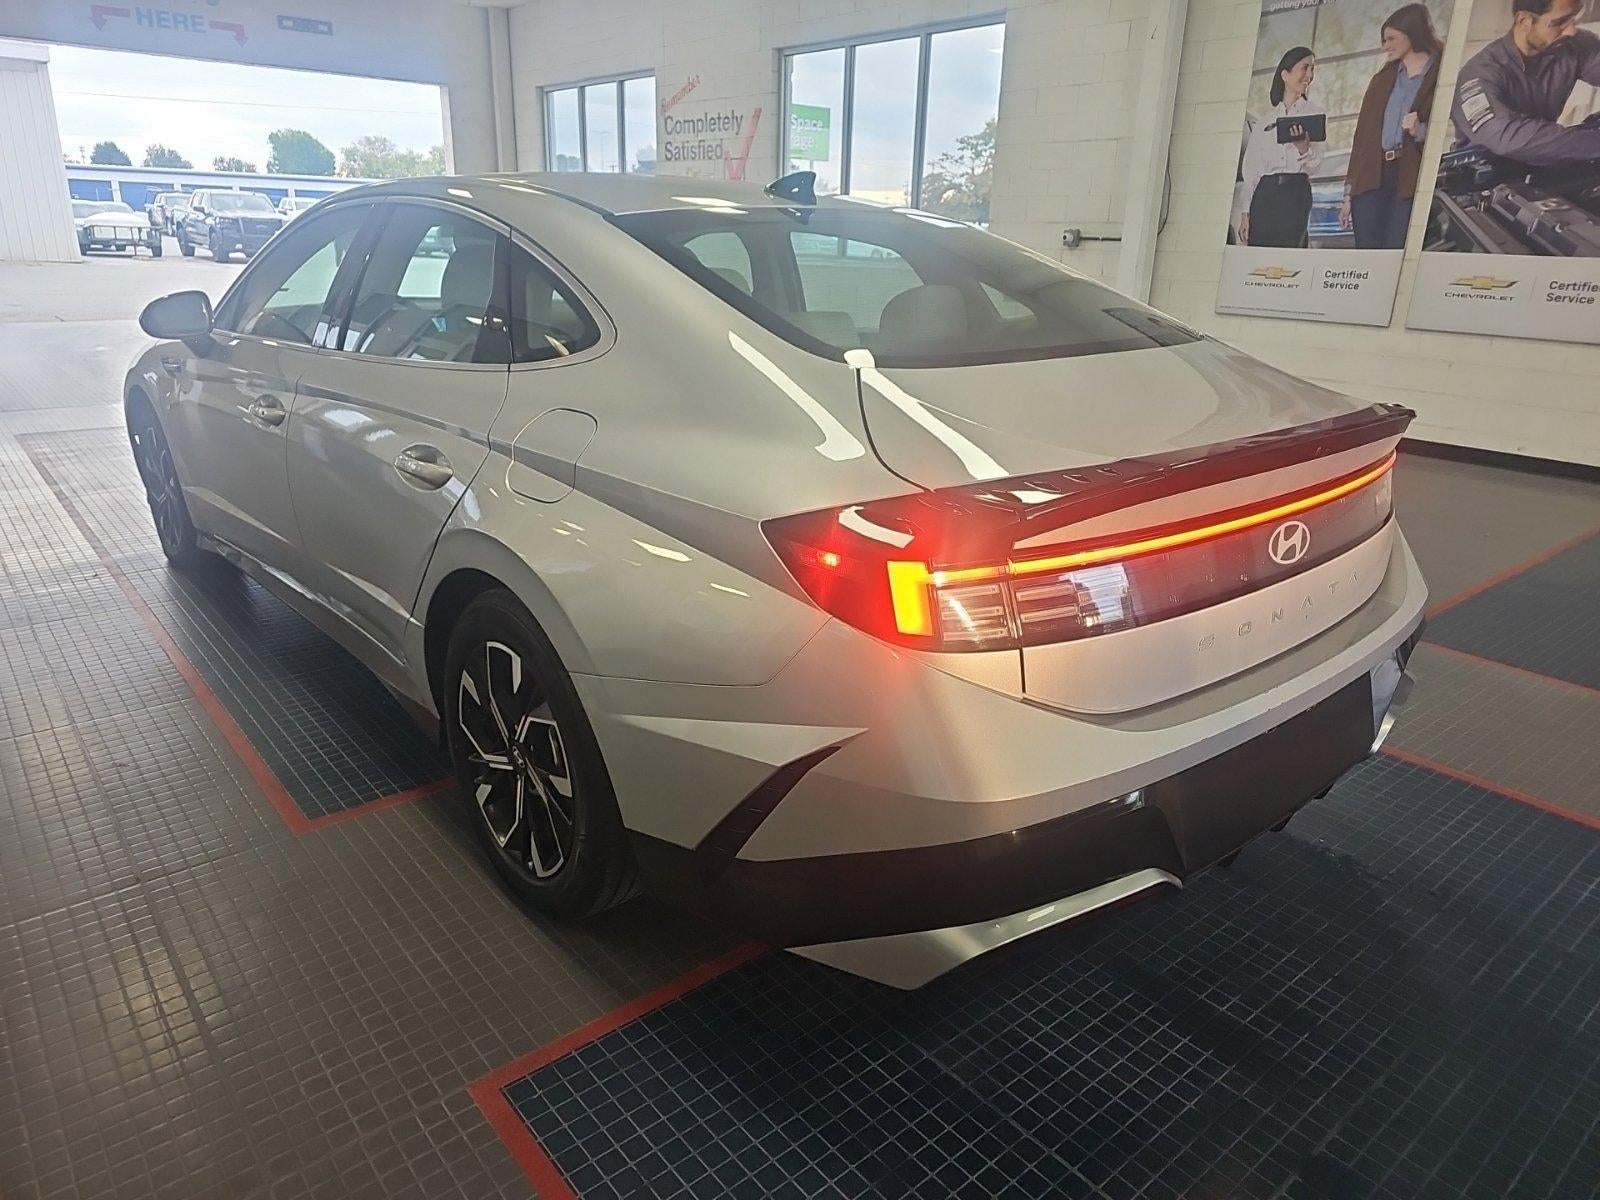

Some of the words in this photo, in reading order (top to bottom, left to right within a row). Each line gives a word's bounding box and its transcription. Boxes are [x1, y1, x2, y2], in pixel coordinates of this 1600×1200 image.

[135, 6, 206, 34] HERE
[664, 109, 743, 138] Completely
[790, 113, 824, 131] Space
[664, 138, 724, 162] Satisfied
[1324, 270, 1369, 280] Certified
[1244, 281, 1300, 289] CHEVROLET
[1322, 280, 1360, 291] Service
[1549, 280, 1600, 293] Certifie
[1444, 291, 1515, 302] CHEVROLET
[1546, 292, 1595, 305] Service
[1198, 571, 1358, 651] SONATA
